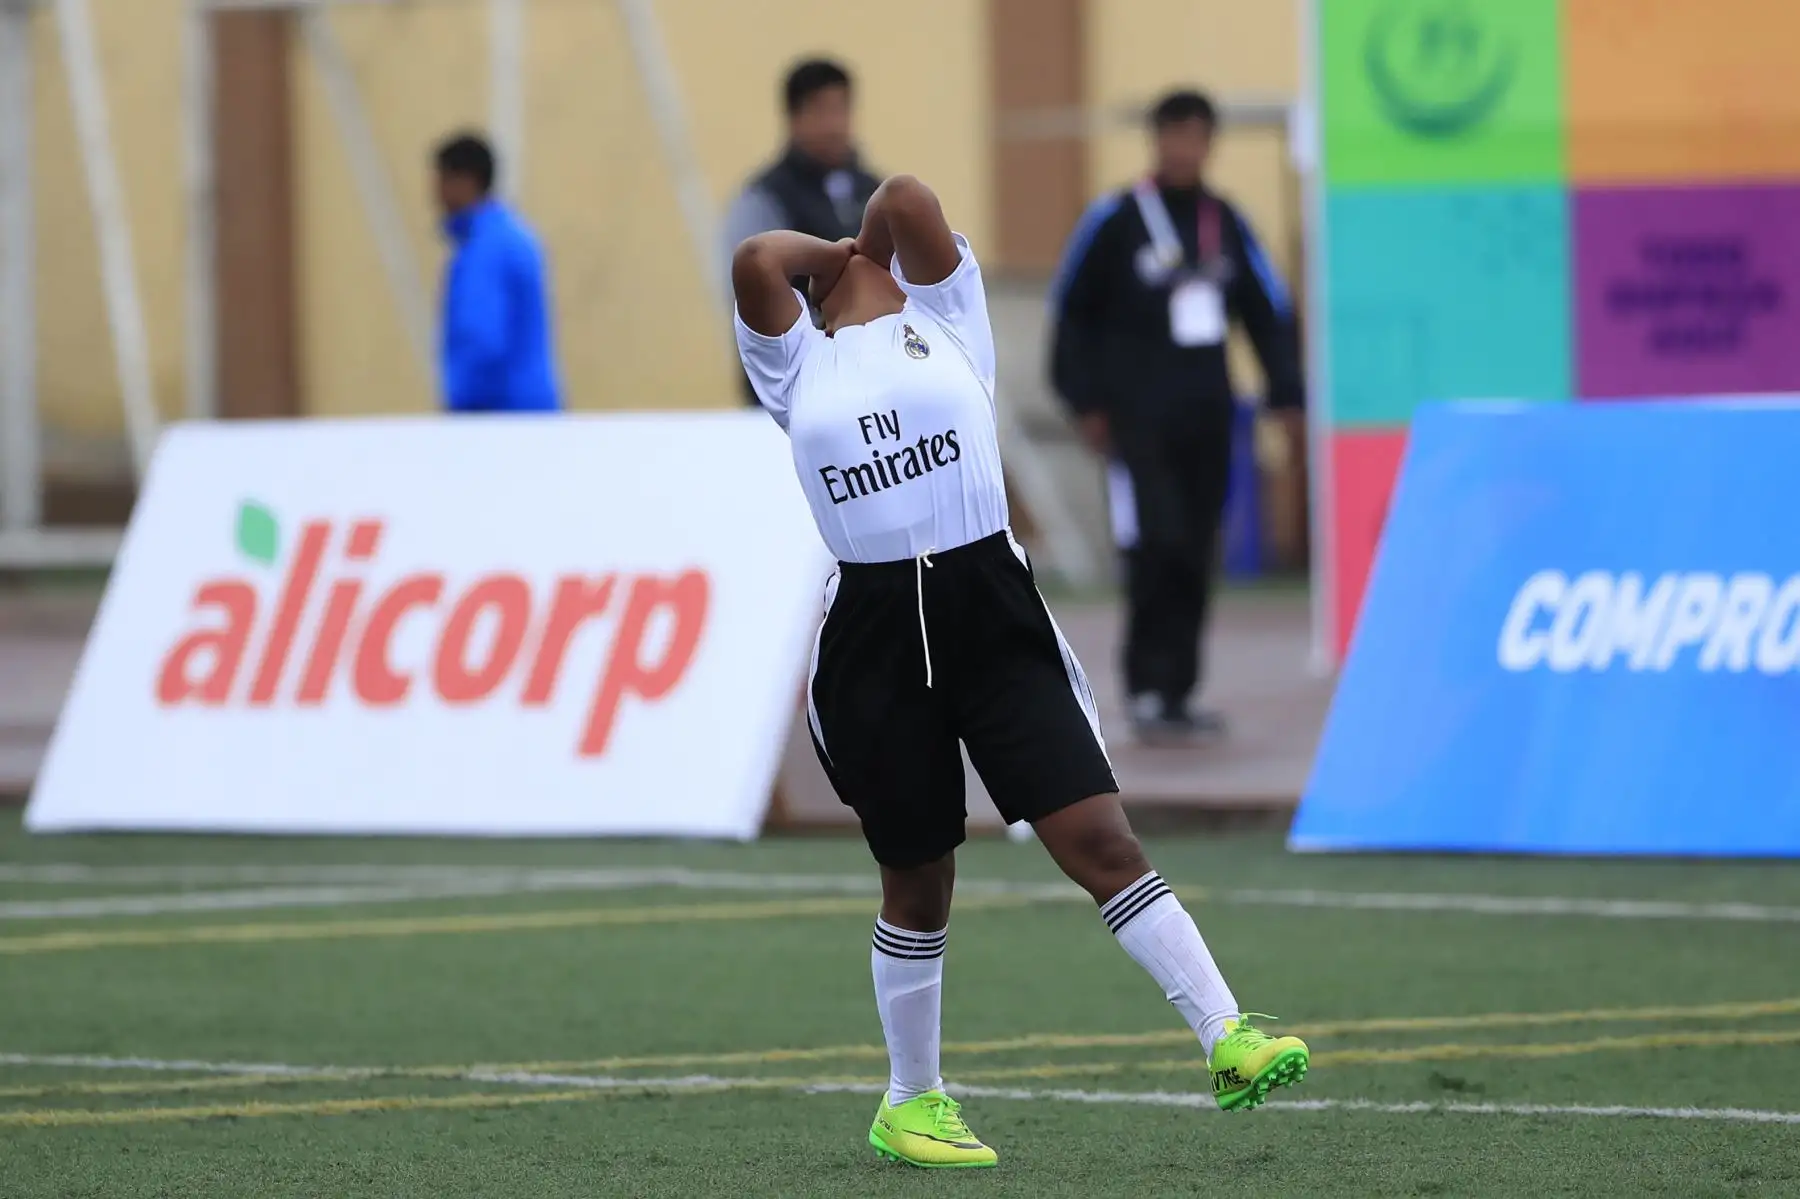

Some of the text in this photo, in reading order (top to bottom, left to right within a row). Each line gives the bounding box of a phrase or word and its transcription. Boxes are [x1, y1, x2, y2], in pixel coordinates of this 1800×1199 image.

[858, 409, 901, 445] Fly
[818, 429, 961, 505] Emirates
[155, 517, 711, 759] alicorp
